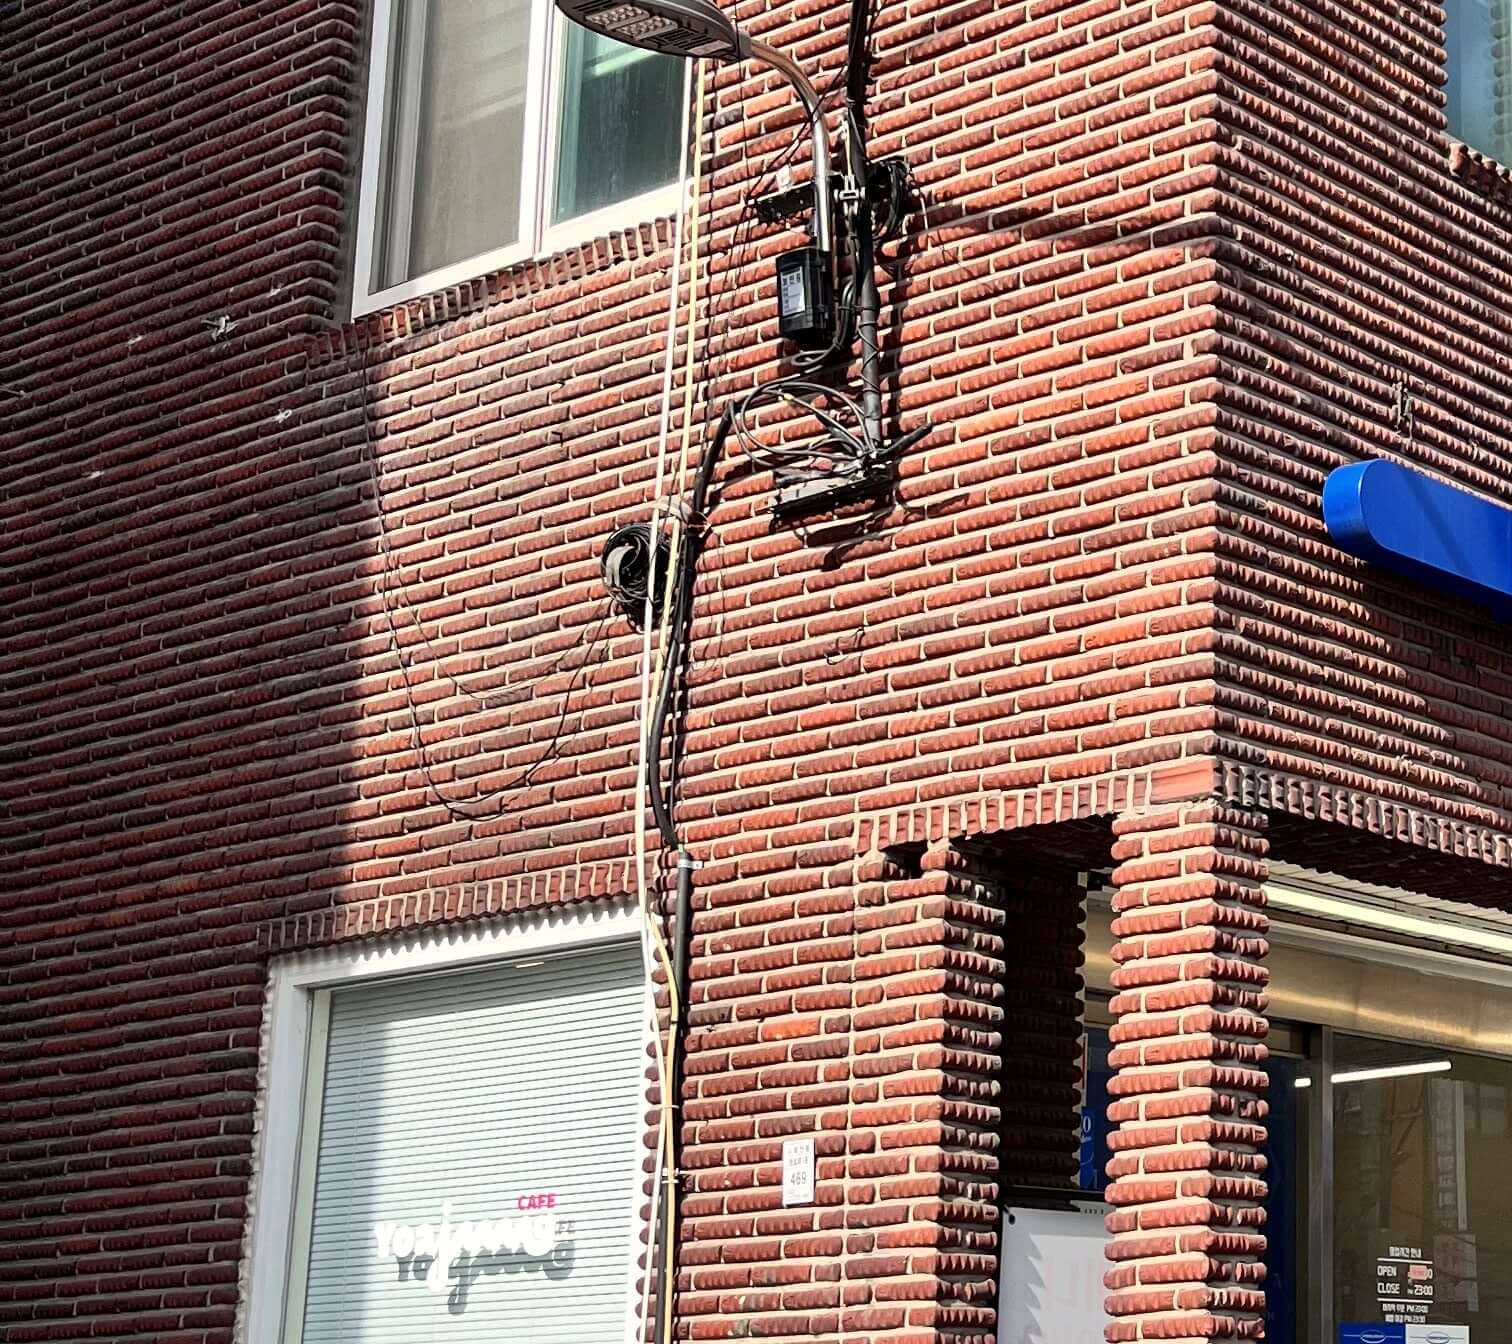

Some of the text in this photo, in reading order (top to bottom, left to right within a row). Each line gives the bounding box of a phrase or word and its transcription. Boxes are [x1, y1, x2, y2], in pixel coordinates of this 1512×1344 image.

[517, 1193, 557, 1211] CAFE
[1377, 1265, 1398, 1277] OPEN
[1377, 1282, 1400, 1294] CLOSE
